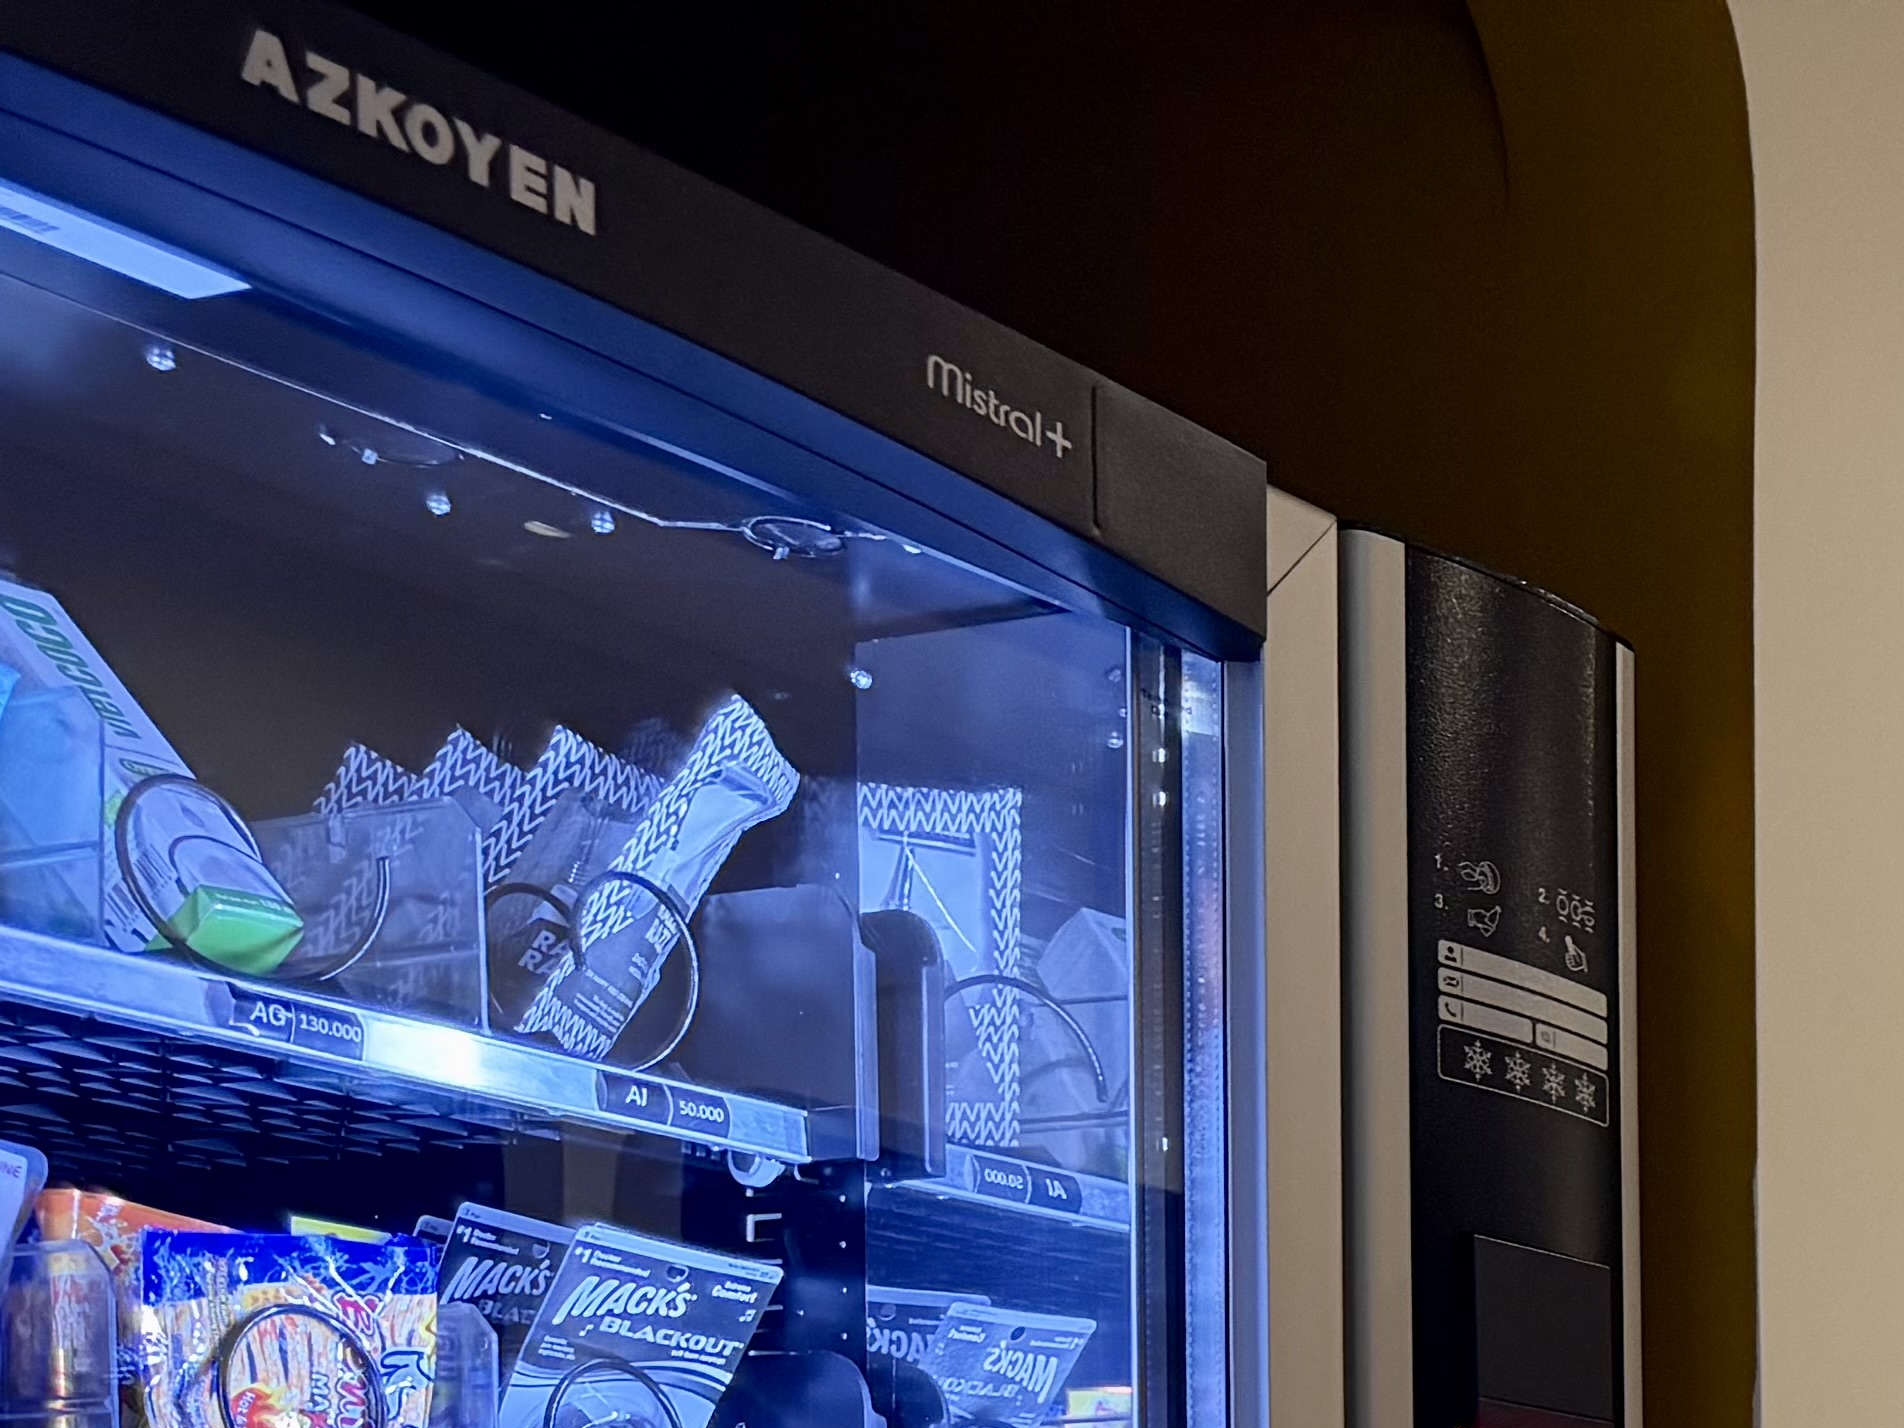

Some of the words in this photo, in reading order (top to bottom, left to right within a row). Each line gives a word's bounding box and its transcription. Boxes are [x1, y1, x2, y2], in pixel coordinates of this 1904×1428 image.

[242, 28, 598, 237] AZKOYEN
[926, 353, 1073, 459] Mistral+
[250, 1000, 286, 1027] AG
[299, 1014, 362, 1043] 130.000
[626, 1085, 648, 1106] AI
[679, 1098, 724, 1124] 50.000
[552, 1275, 692, 1325] MACK'S
[599, 1316, 743, 1356] BLACKOUT
